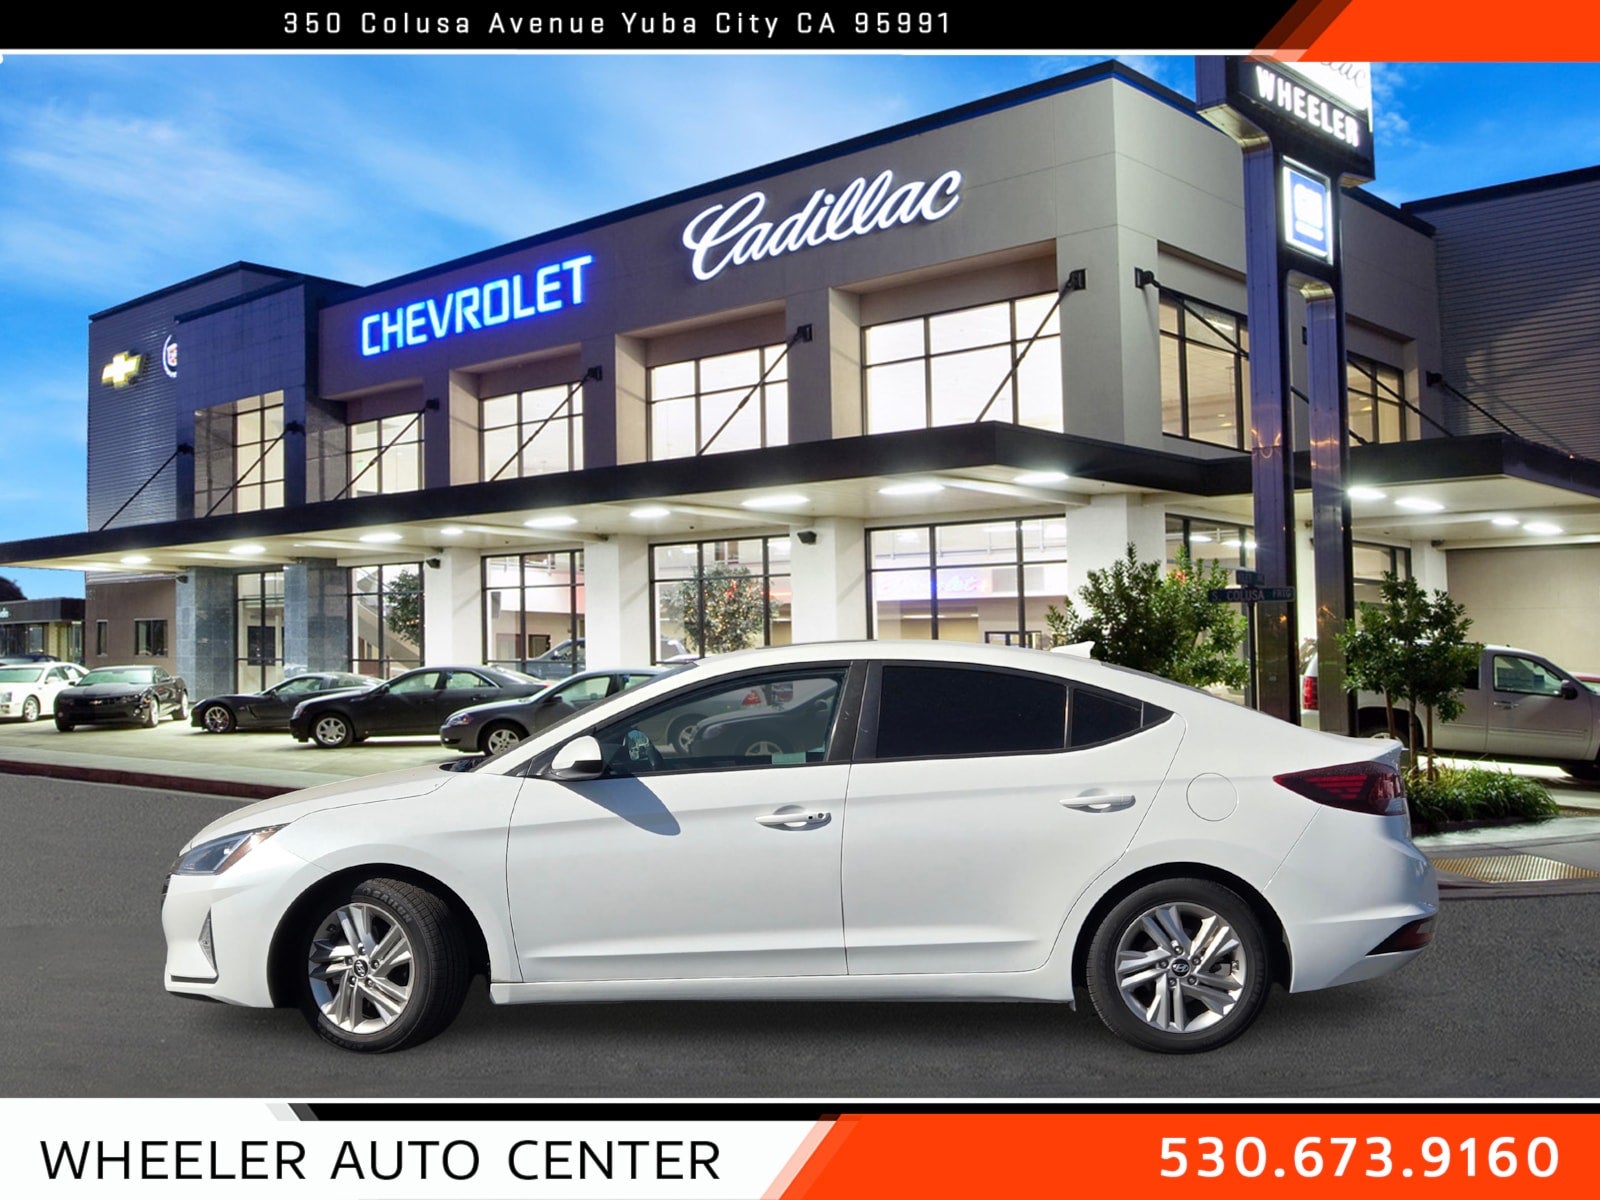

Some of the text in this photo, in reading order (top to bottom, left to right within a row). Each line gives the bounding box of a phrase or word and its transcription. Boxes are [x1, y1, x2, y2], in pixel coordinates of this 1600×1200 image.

[1255, 65, 1359, 147] WHEELER
[682, 168, 963, 282] Cadillac
[360, 254, 595, 357] CHEVROLET
[1226, 588, 1265, 601] COLUSA
